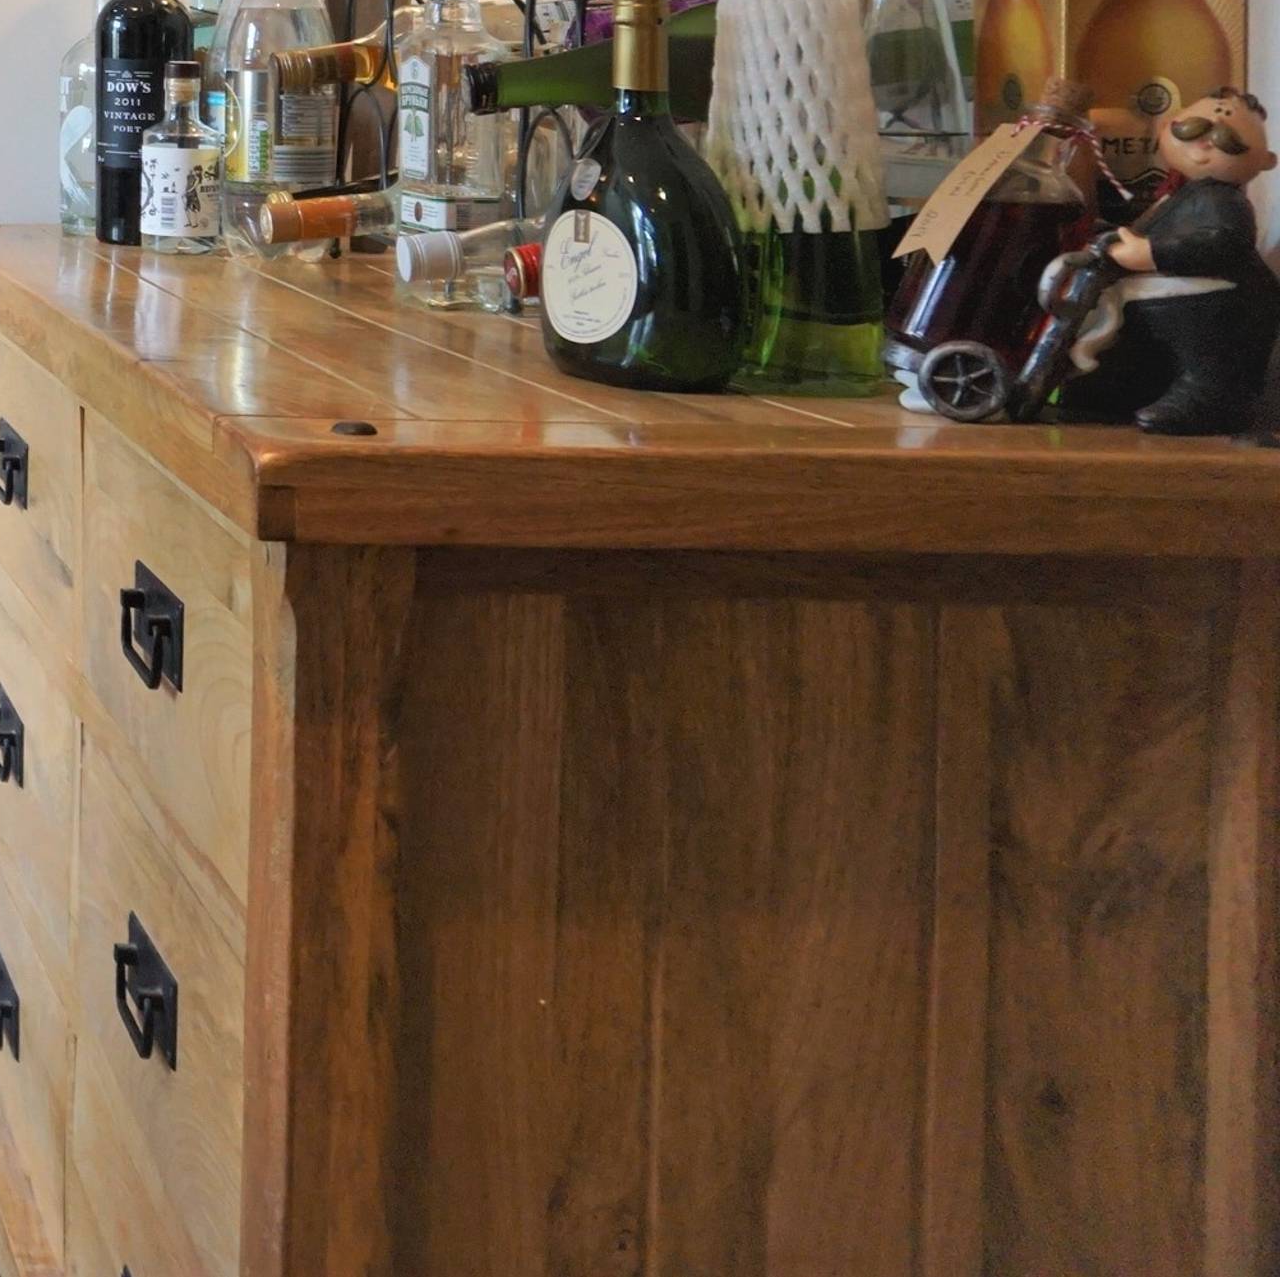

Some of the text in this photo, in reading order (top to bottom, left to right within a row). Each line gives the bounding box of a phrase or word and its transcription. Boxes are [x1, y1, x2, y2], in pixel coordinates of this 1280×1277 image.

[106, 80, 152, 94] DOW'S
[113, 97, 141, 107] 2011
[103, 110, 157, 121] VINTAGE
[112, 125, 142, 134] PORT
